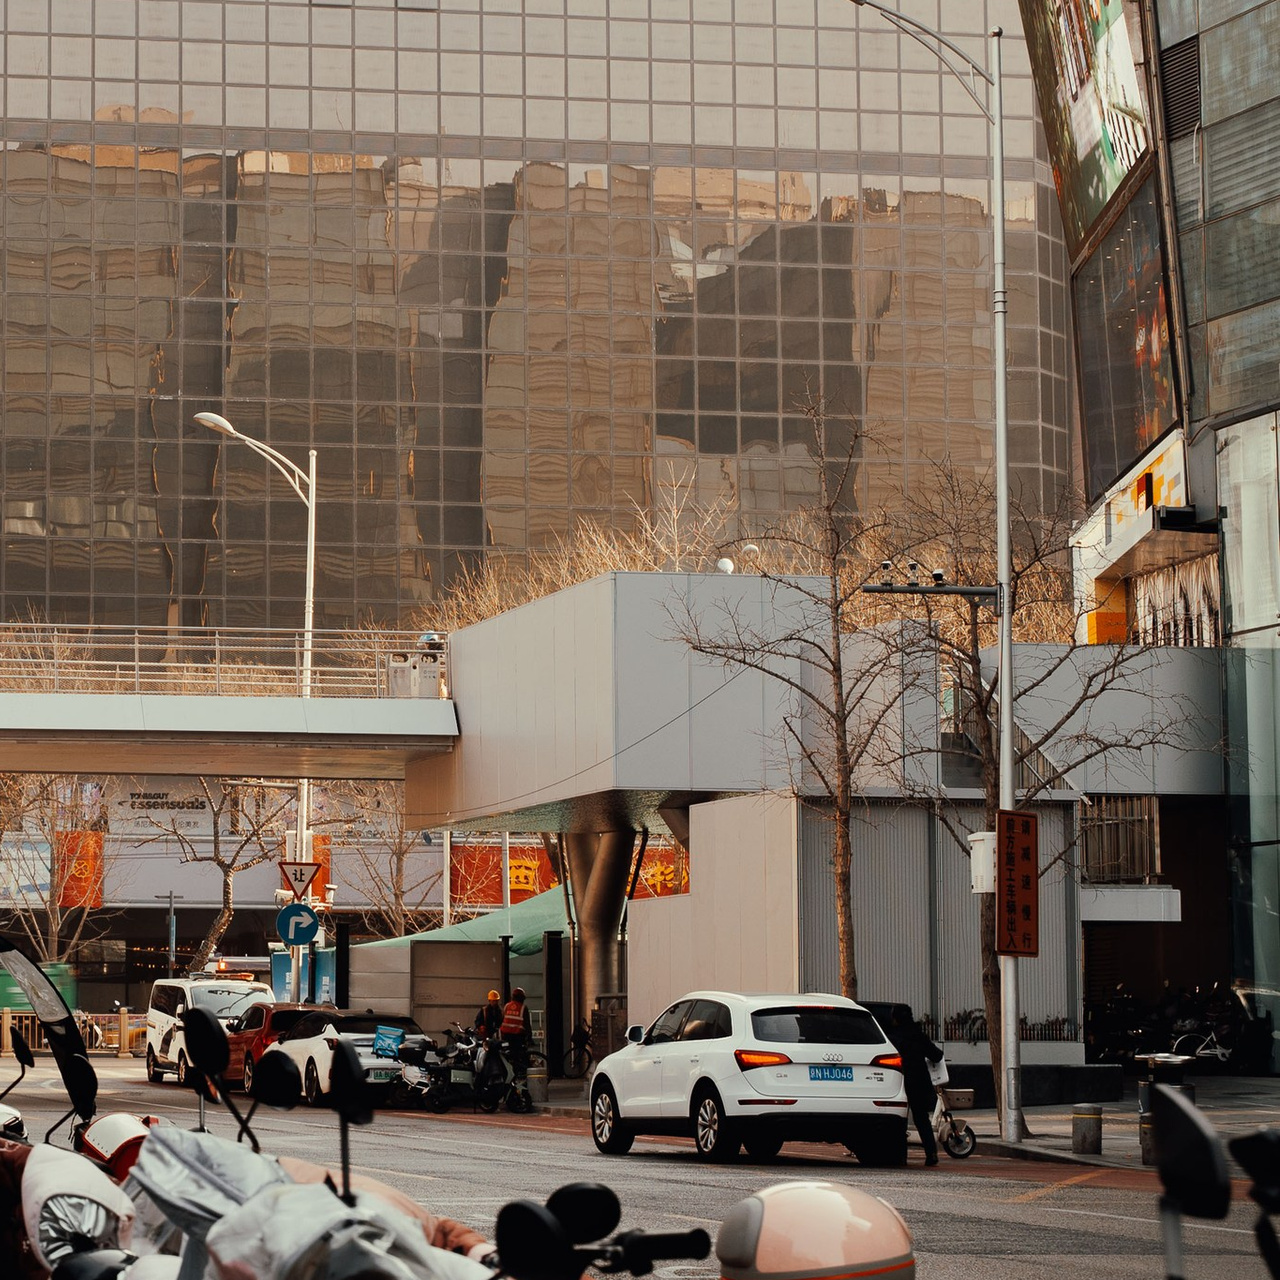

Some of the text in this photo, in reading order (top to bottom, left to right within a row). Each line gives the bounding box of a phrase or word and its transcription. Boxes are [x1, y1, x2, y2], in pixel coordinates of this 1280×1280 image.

[130, 797, 207, 810] essensuals
[292, 868, 306, 883] 让
[1005, 818, 1017, 949] 前方施工车辆出入
[1020, 819, 1032, 949] 请减速慢行
